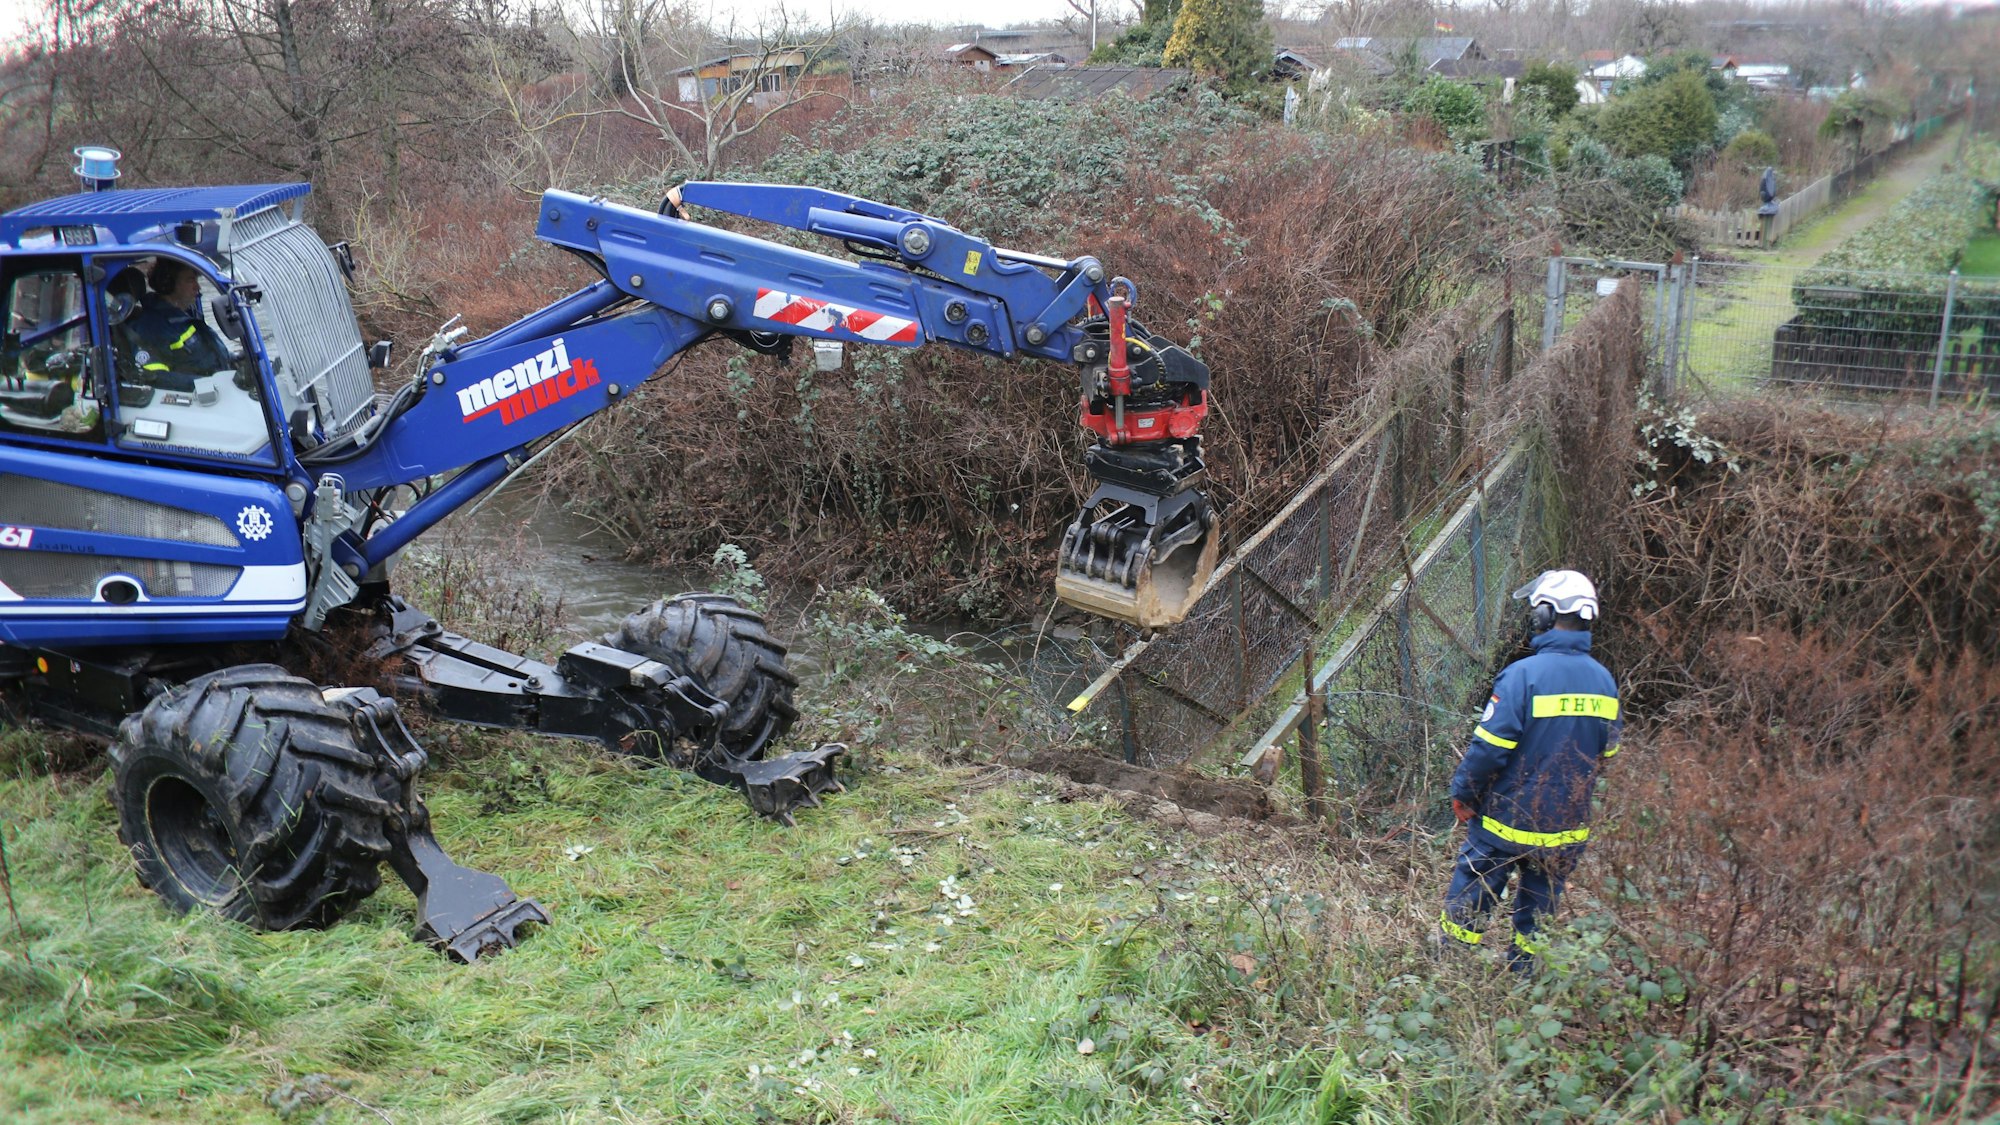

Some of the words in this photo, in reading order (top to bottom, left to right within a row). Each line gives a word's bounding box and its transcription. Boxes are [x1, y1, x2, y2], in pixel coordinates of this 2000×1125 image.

[456, 337, 572, 416] menzi
[498, 357, 601, 426] muck
[141, 440, 249, 461] www.menzimuck.com
[0, 526, 34, 548] 61
[1560, 698, 1602, 712] THW
